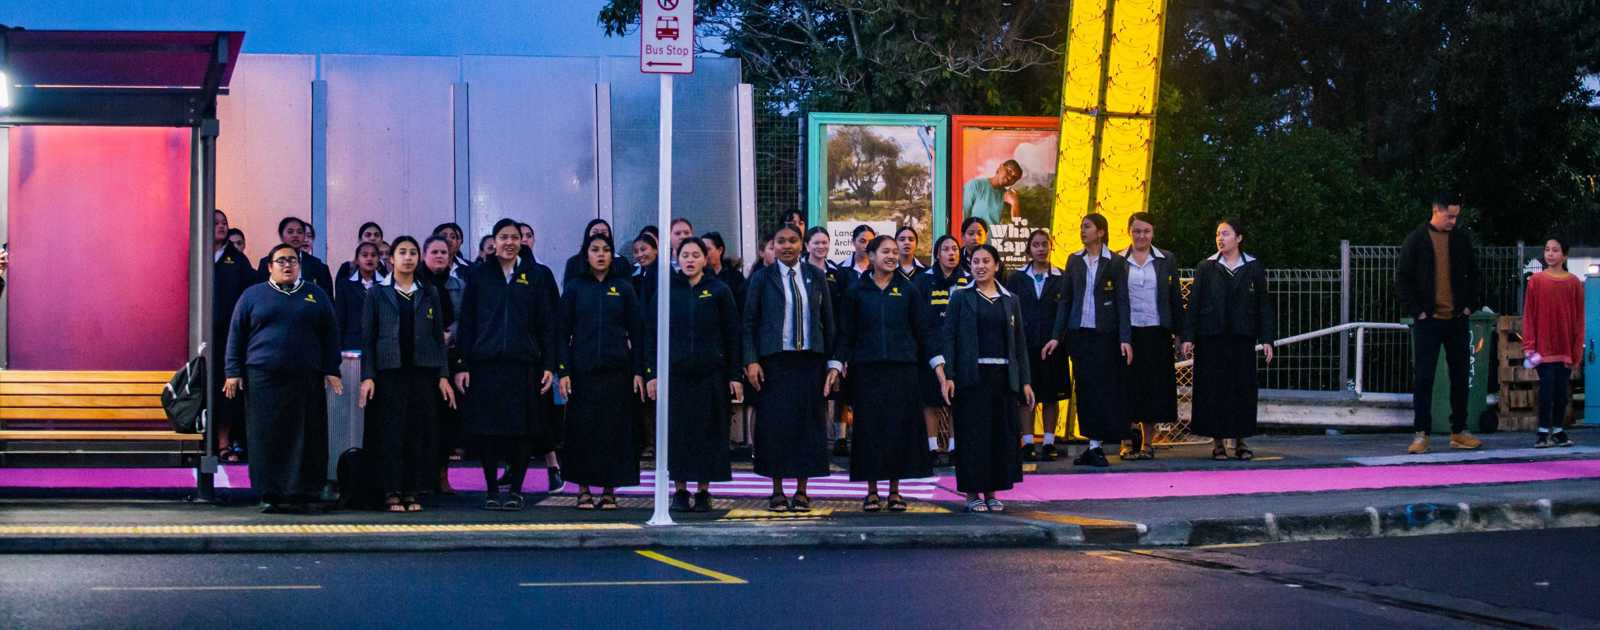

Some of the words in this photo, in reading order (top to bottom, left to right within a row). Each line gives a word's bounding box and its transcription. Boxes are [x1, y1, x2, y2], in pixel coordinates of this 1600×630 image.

[645, 44, 664, 55] Bus
[666, 44, 689, 56] Stop
[991, 238, 1028, 256] Kap
